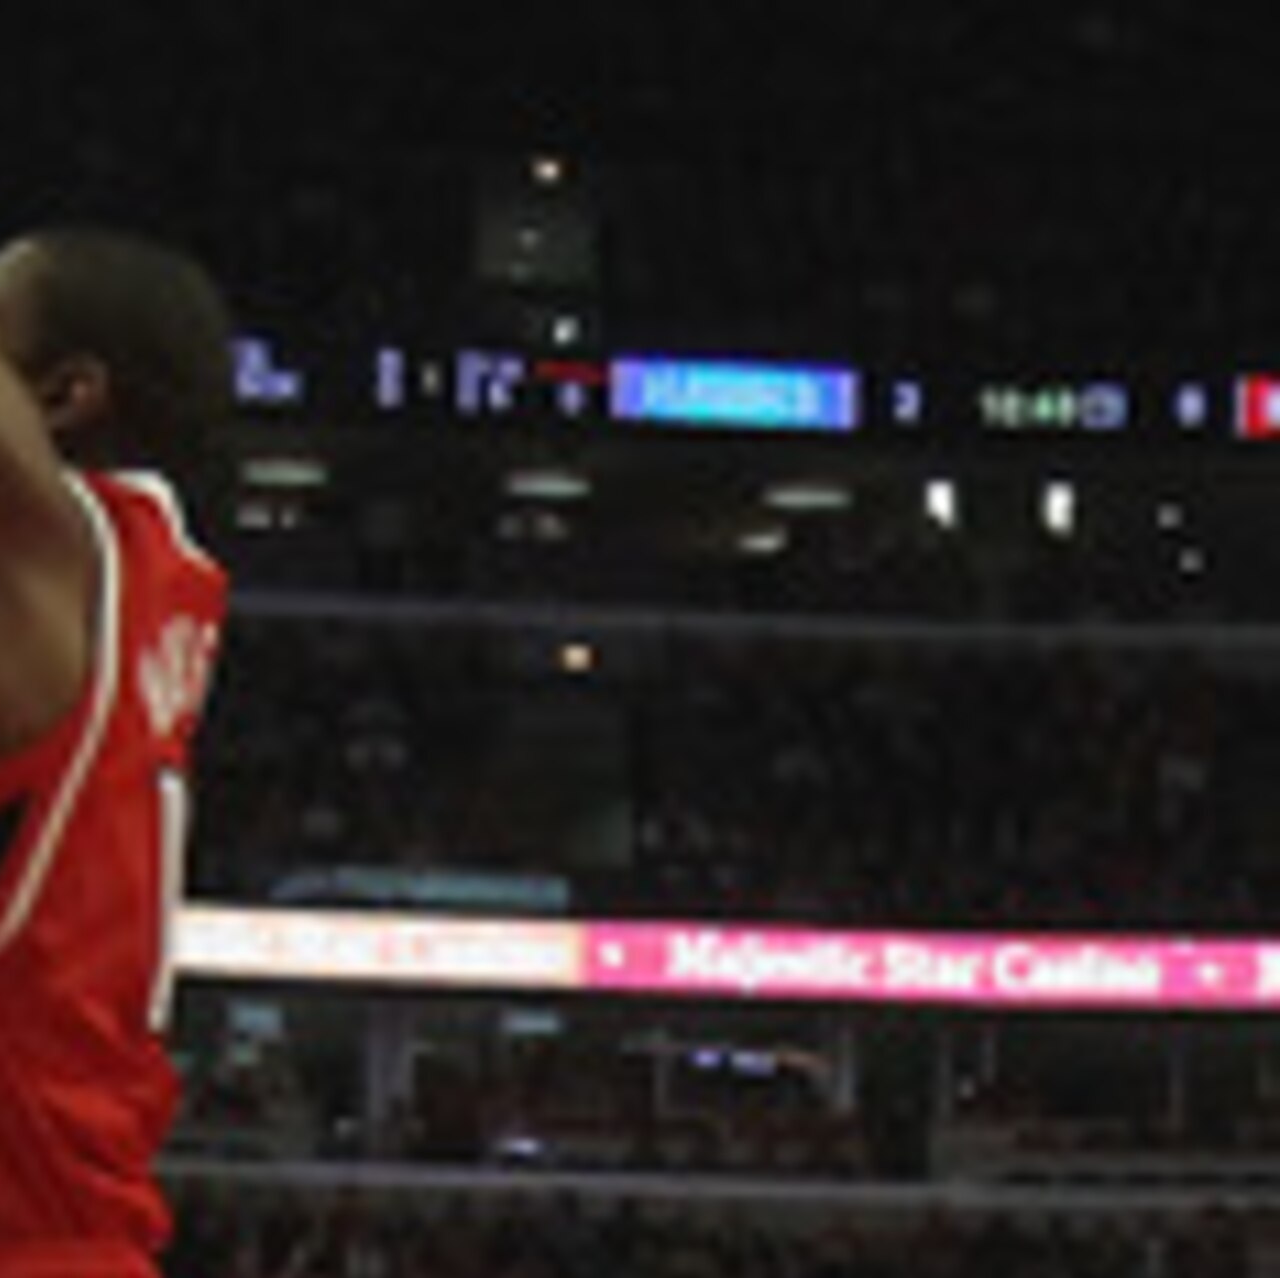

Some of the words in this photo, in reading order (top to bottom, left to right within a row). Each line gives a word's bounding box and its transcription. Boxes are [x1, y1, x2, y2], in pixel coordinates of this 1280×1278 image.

[666, 930, 870, 994] Majestic
[882, 940, 980, 992] Star
[991, 940, 1161, 998] Casino
